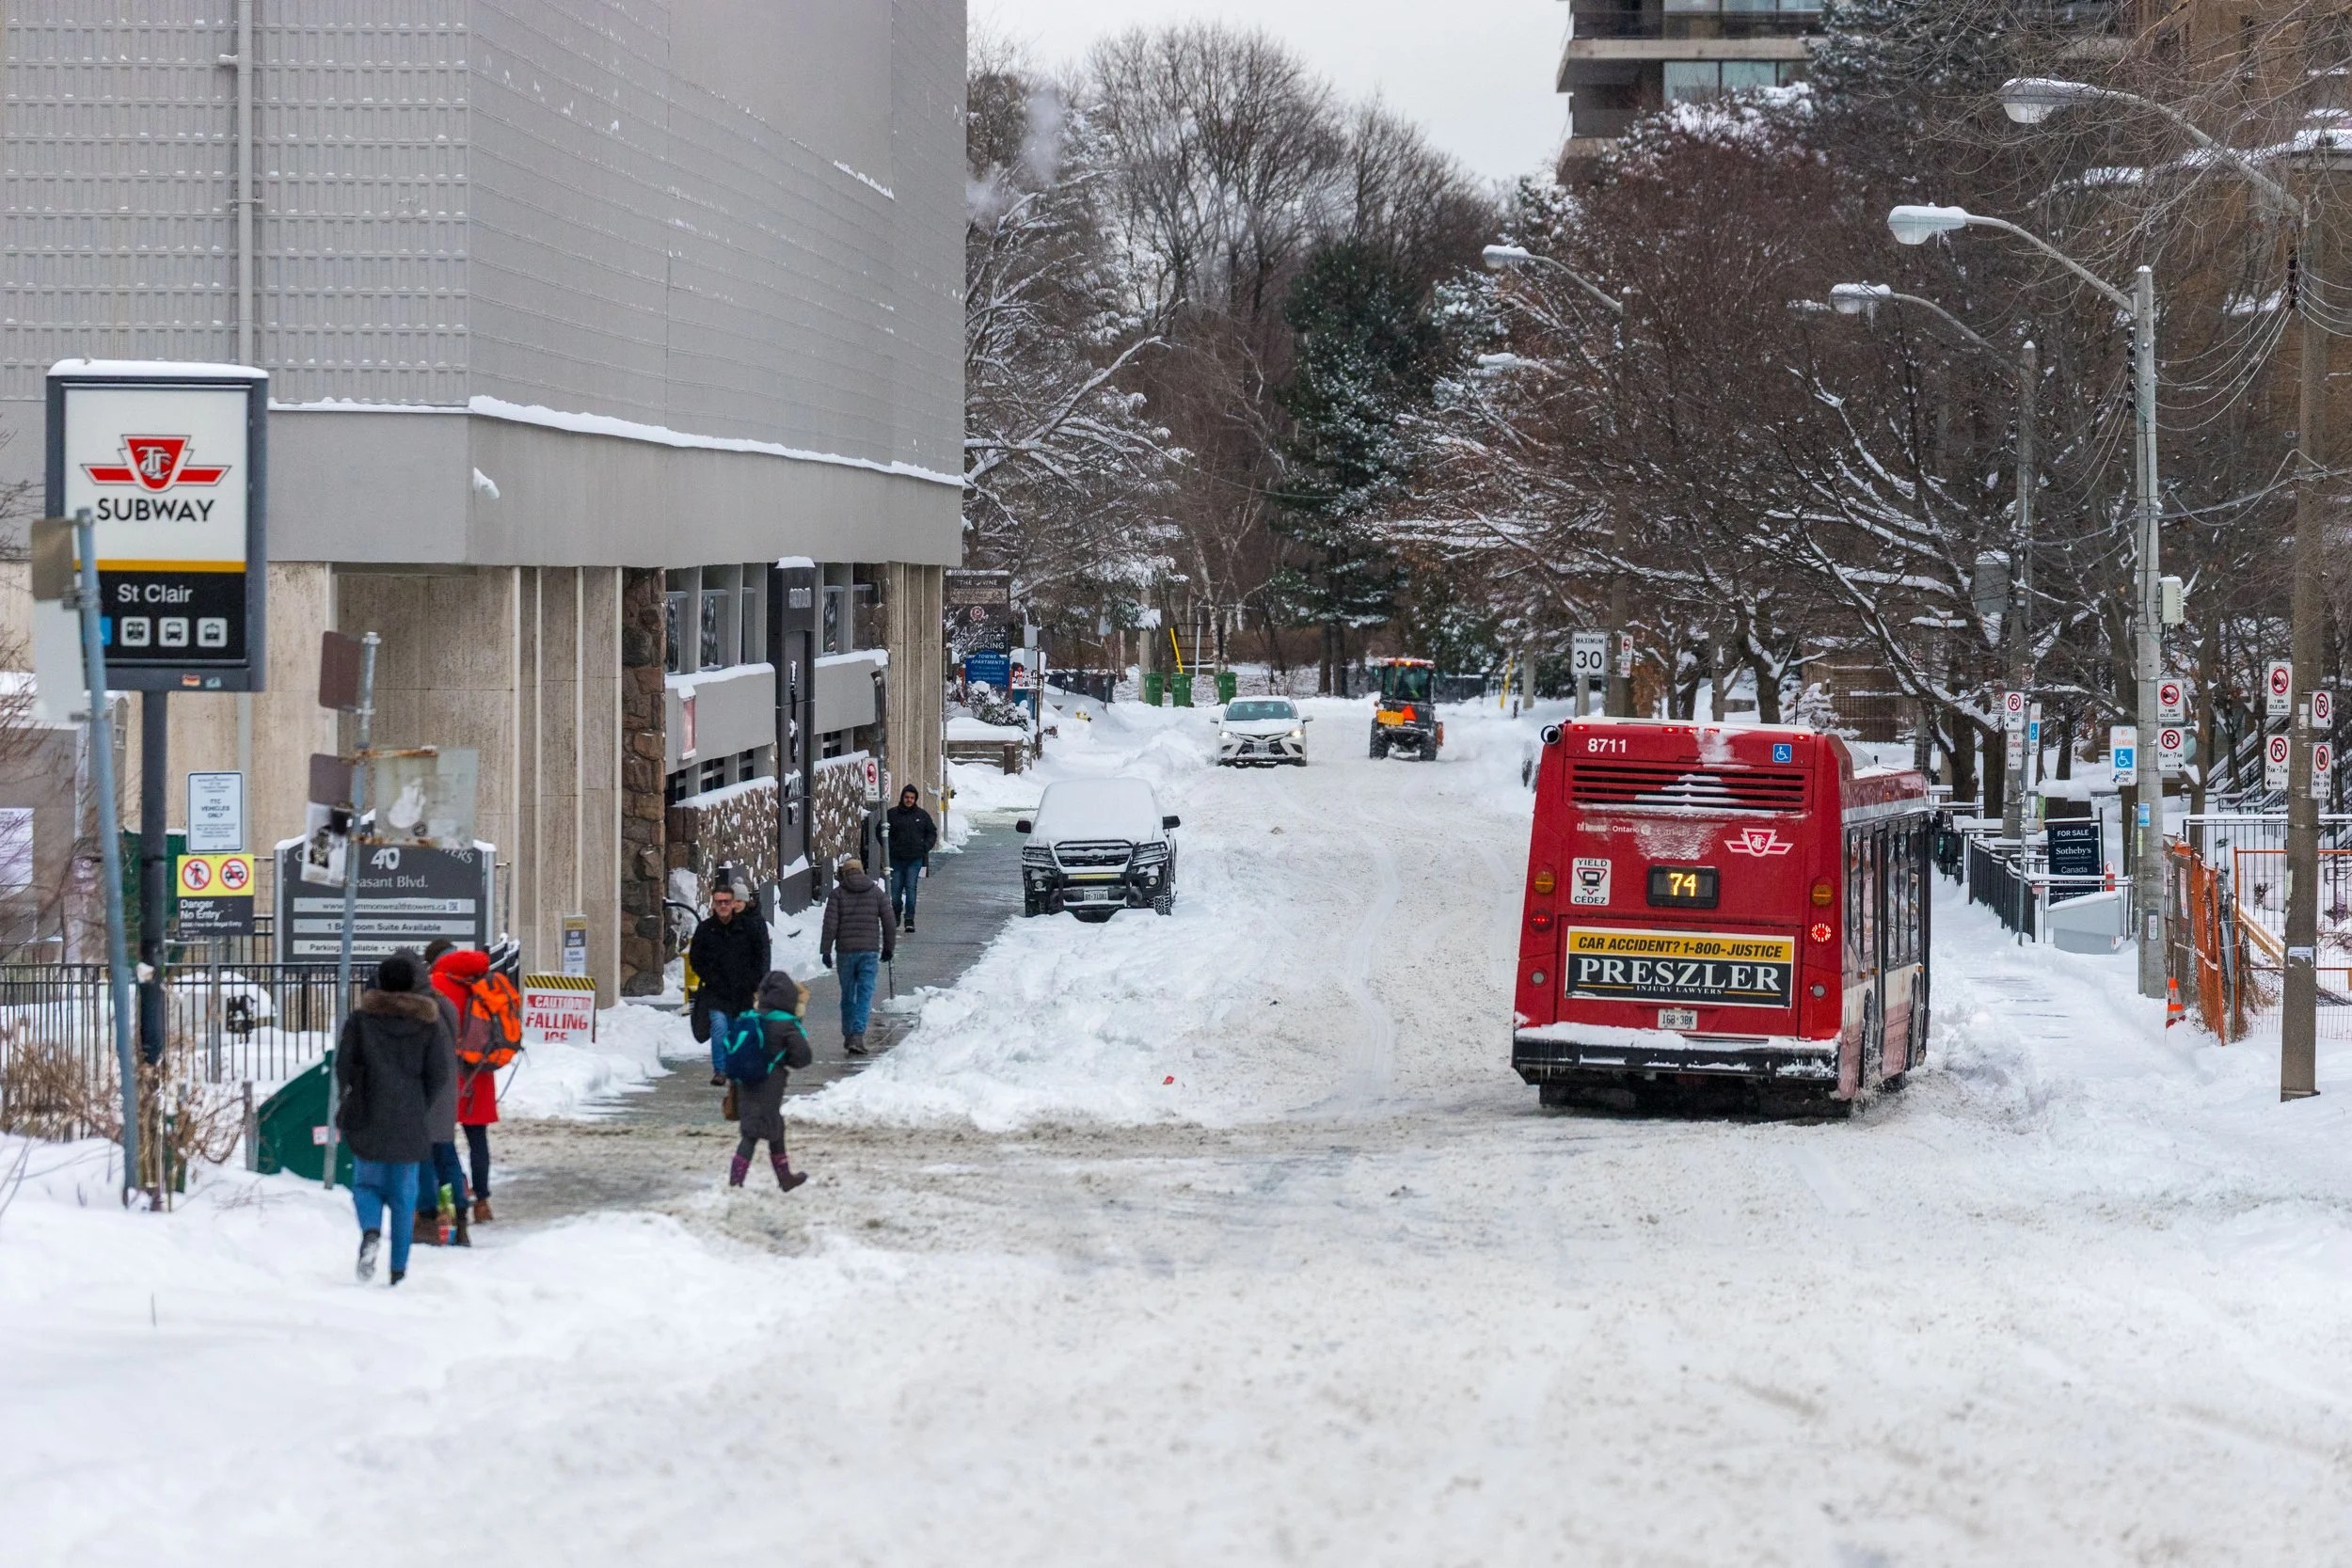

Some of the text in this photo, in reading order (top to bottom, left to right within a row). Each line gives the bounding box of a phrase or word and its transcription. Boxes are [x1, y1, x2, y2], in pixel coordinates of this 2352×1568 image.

[97, 498, 215, 522] SUBWAY
[118, 584, 193, 603] St Clair
[1576, 650, 1603, 669] 30
[1587, 738, 1627, 752] 8711
[1613, 825, 1639, 833] Ontario
[2056, 847, 2091, 855] Sotheby's
[371, 847, 401, 870] 40
[1578, 859, 1608, 867] YIELD
[396, 876, 429, 888] Blvd.
[1669, 873, 1696, 896] 74
[180, 899, 215, 911] Danger
[1574, 895, 1606, 904] CÉDEZ
[180, 910, 221, 920] No Entry
[377, 923, 400, 931] Suite
[402, 923, 440, 931] Available
[310, 944, 341, 955] Parking
[1578, 937, 1784, 958] CAR ACCIDENT? 1-800-JUSTICE
[1578, 958, 1781, 991] PRESZLER
[1676, 987, 1722, 995] LAWYERS
[525, 1012, 588, 1030] FALLING
